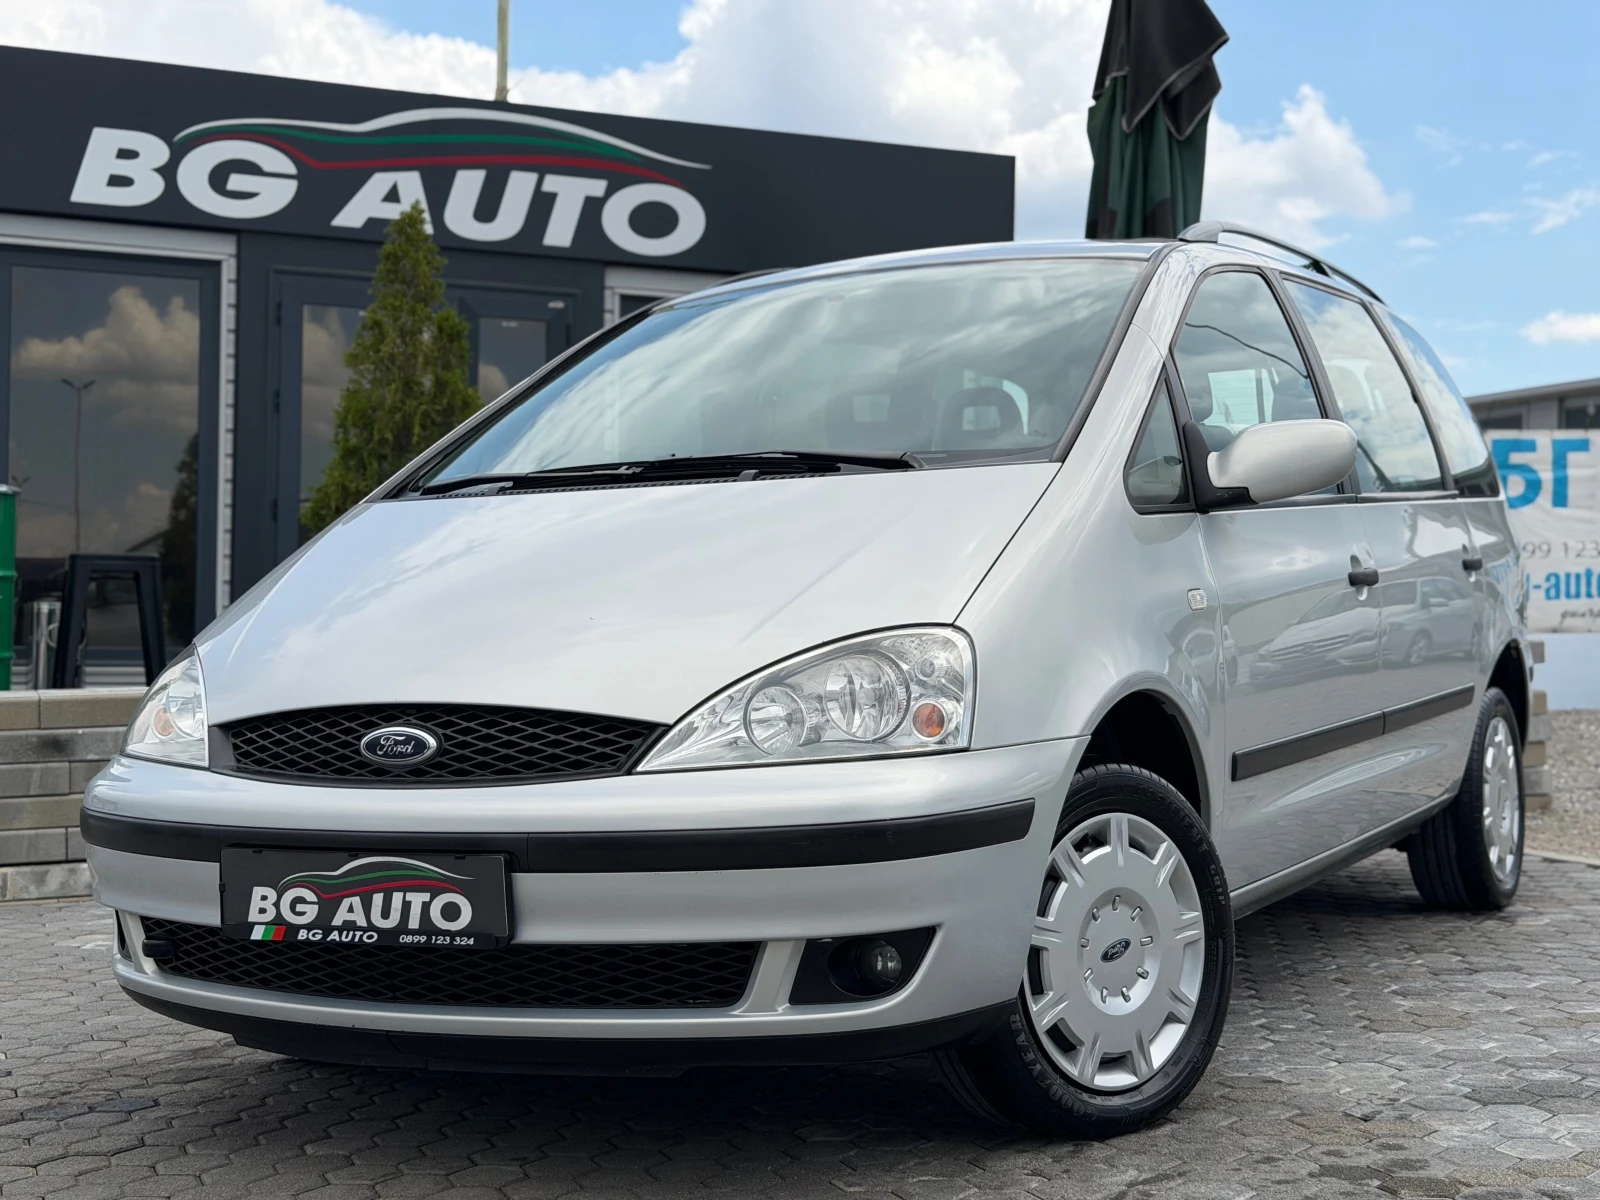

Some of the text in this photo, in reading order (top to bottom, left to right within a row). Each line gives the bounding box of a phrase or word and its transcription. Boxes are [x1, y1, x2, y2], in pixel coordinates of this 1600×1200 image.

[70, 126, 706, 257] BG AUTO
[1525, 568, 1600, 602] -aut
[376, 735, 415, 755] Ford
[248, 886, 473, 931] BG AUTO
[297, 929, 475, 946] BG AUTO 0899 123 324
